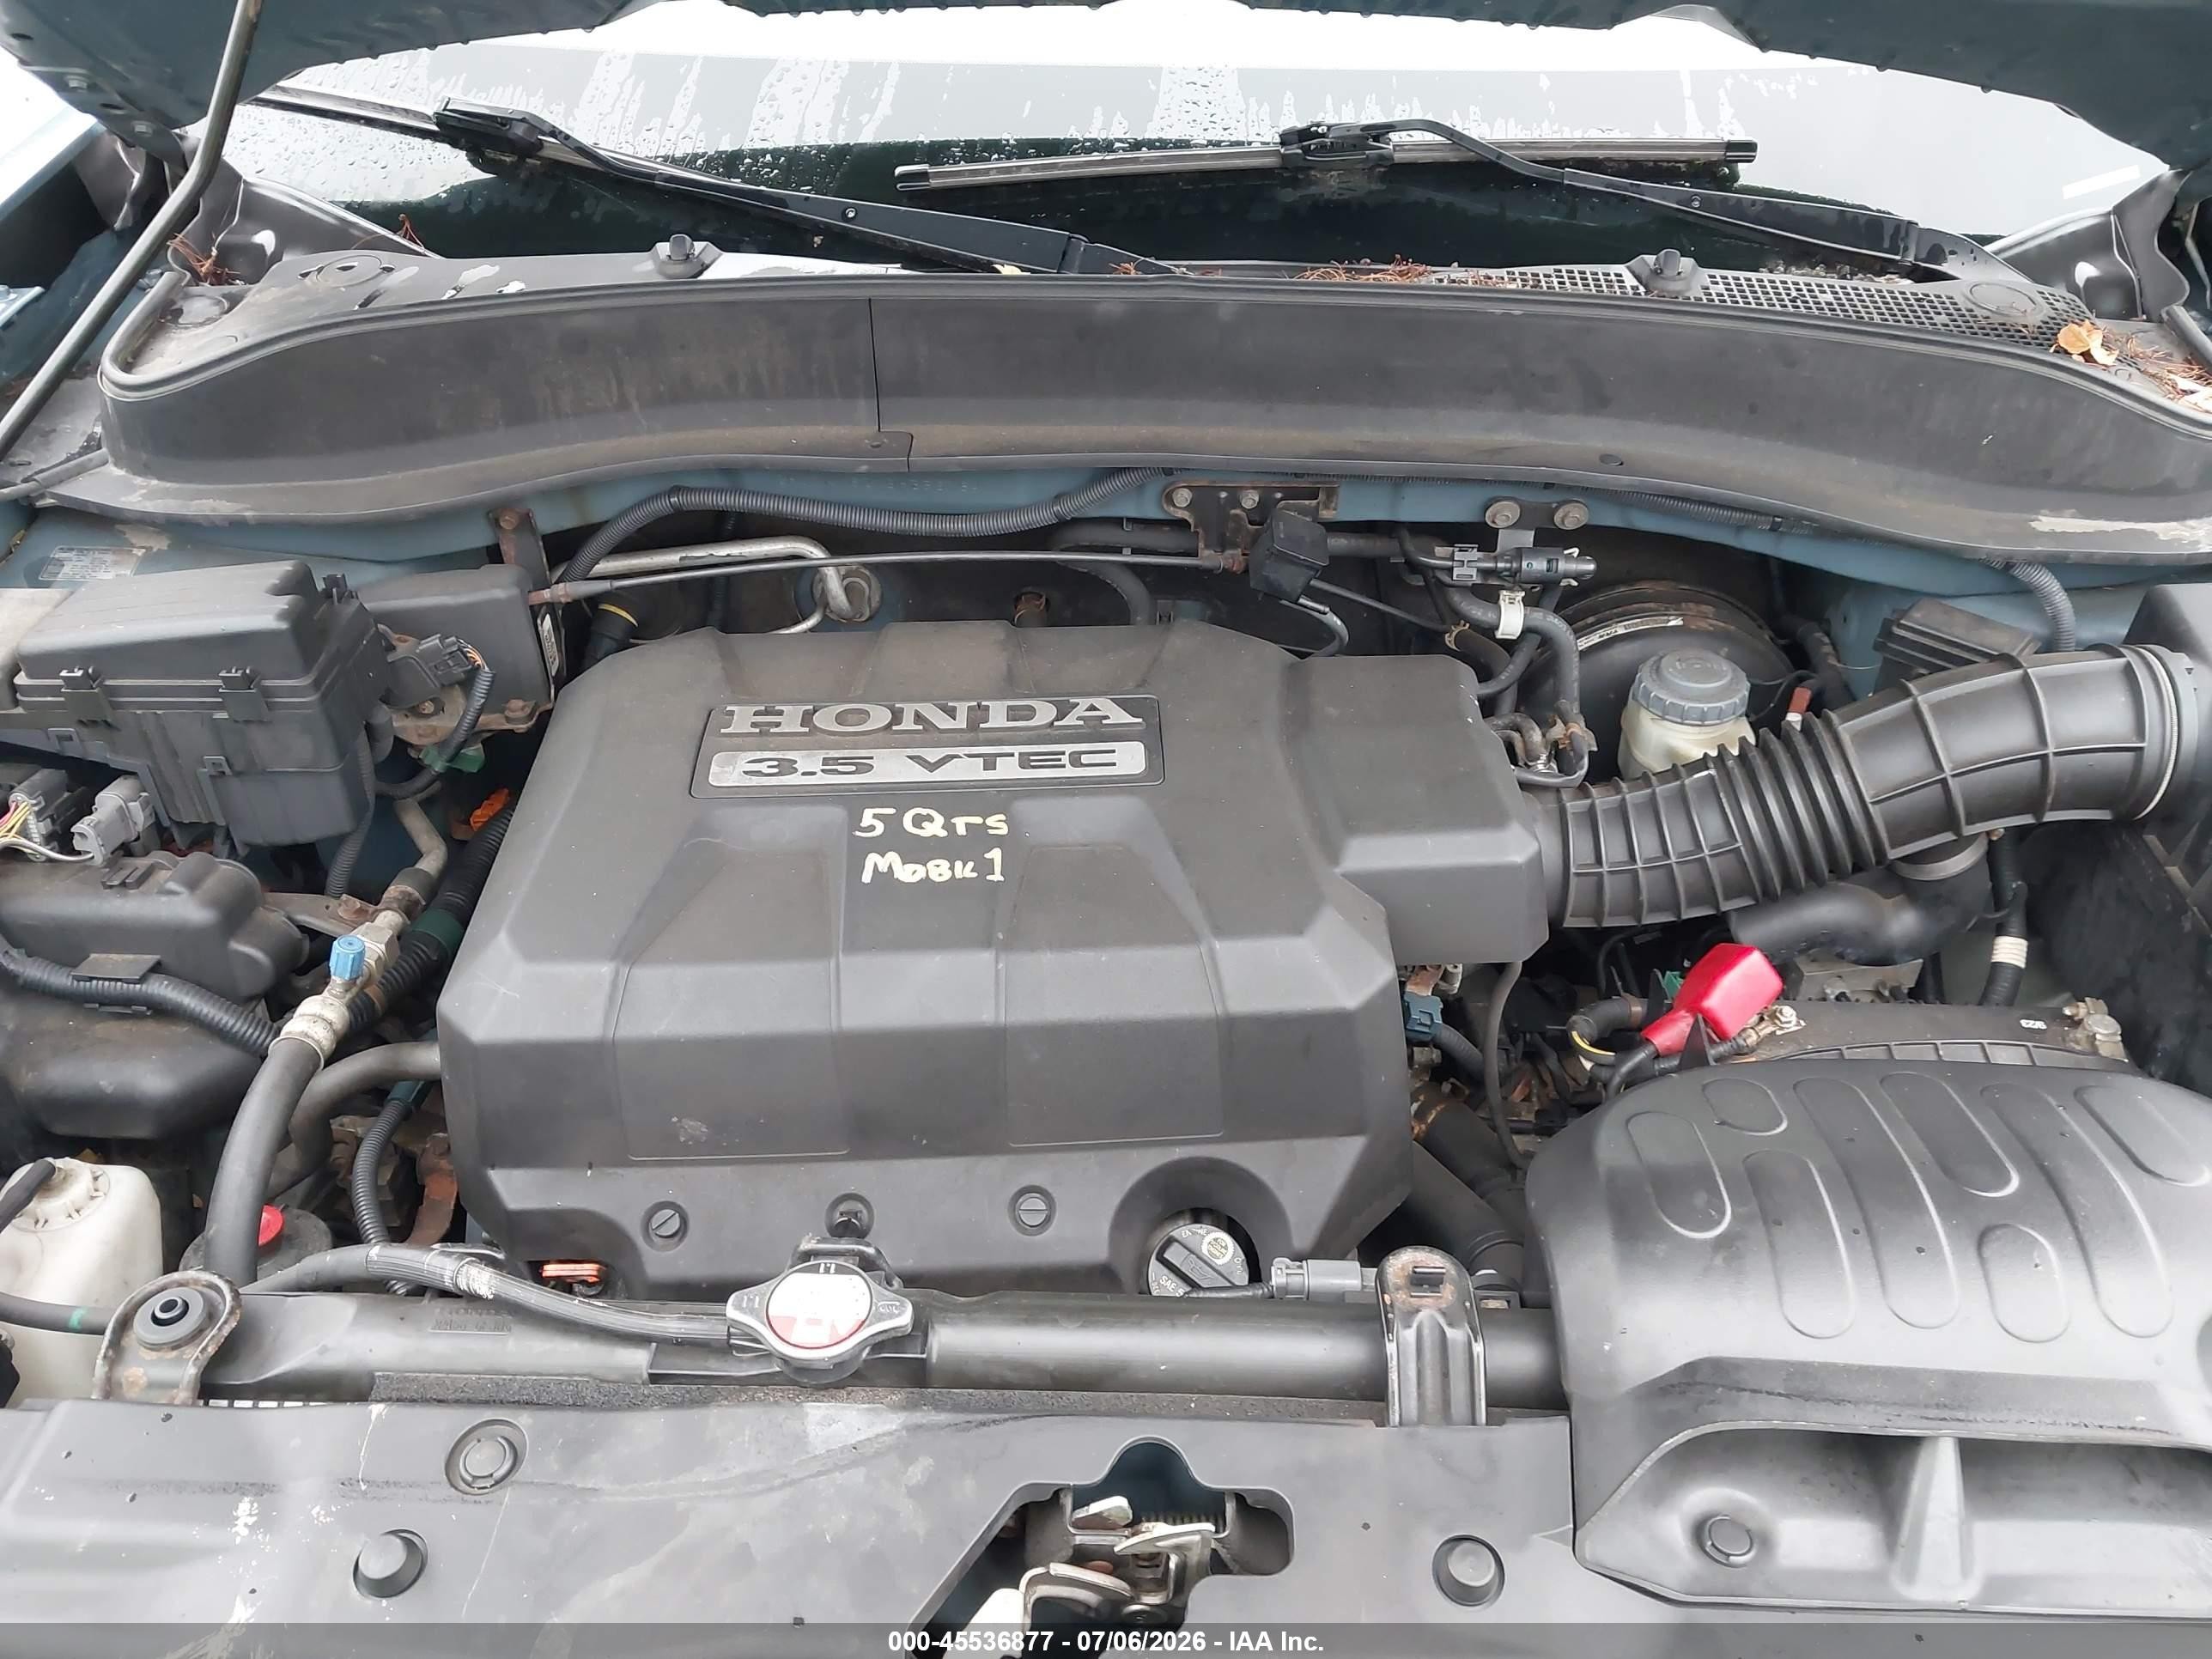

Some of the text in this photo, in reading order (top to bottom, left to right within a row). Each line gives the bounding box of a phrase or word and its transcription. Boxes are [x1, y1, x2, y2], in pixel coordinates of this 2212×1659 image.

[720, 698, 1143, 732] HONDA
[742, 749, 1116, 777] 3.5 VTEC
[853, 807, 896, 837] 5
[984, 847, 1005, 882] 1
